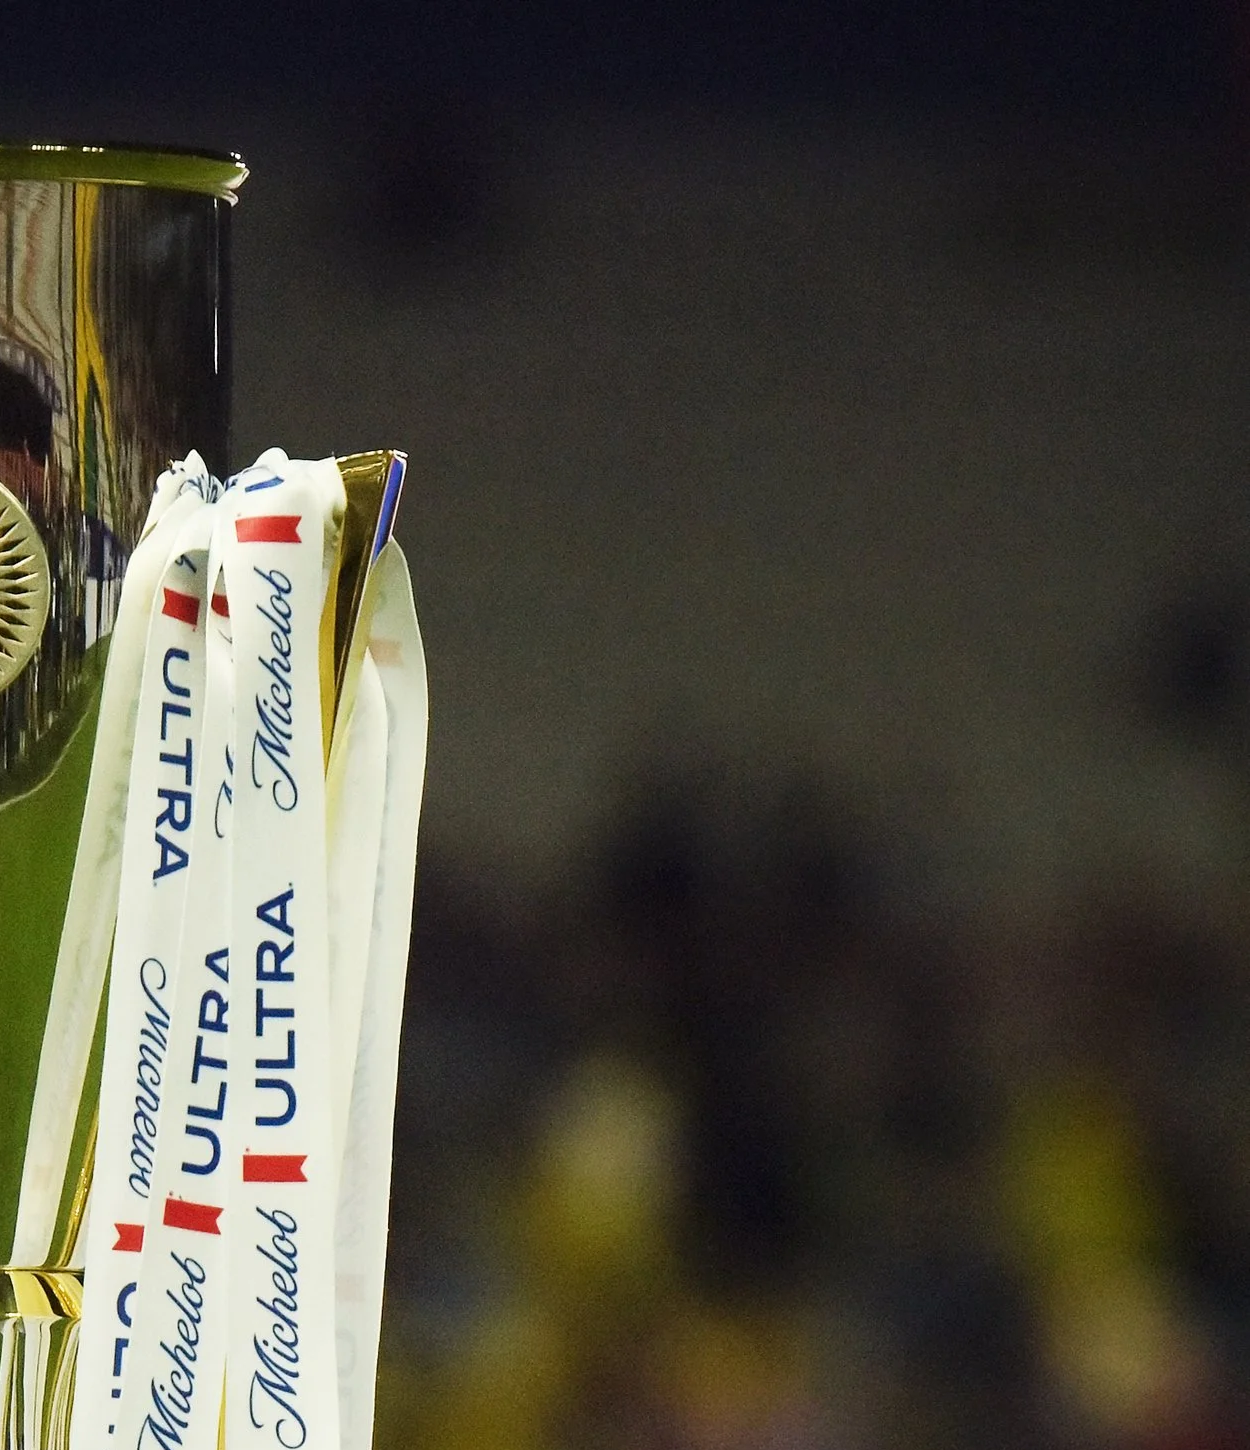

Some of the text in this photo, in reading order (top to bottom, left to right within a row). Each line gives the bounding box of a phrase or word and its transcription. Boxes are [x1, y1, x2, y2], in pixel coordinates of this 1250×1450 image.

[152, 645, 193, 881] ULTRA
[251, 566, 299, 812] Michelob
[181, 946, 230, 1177] ULTRA
[248, 887, 307, 1450] Michelob ULTRA
